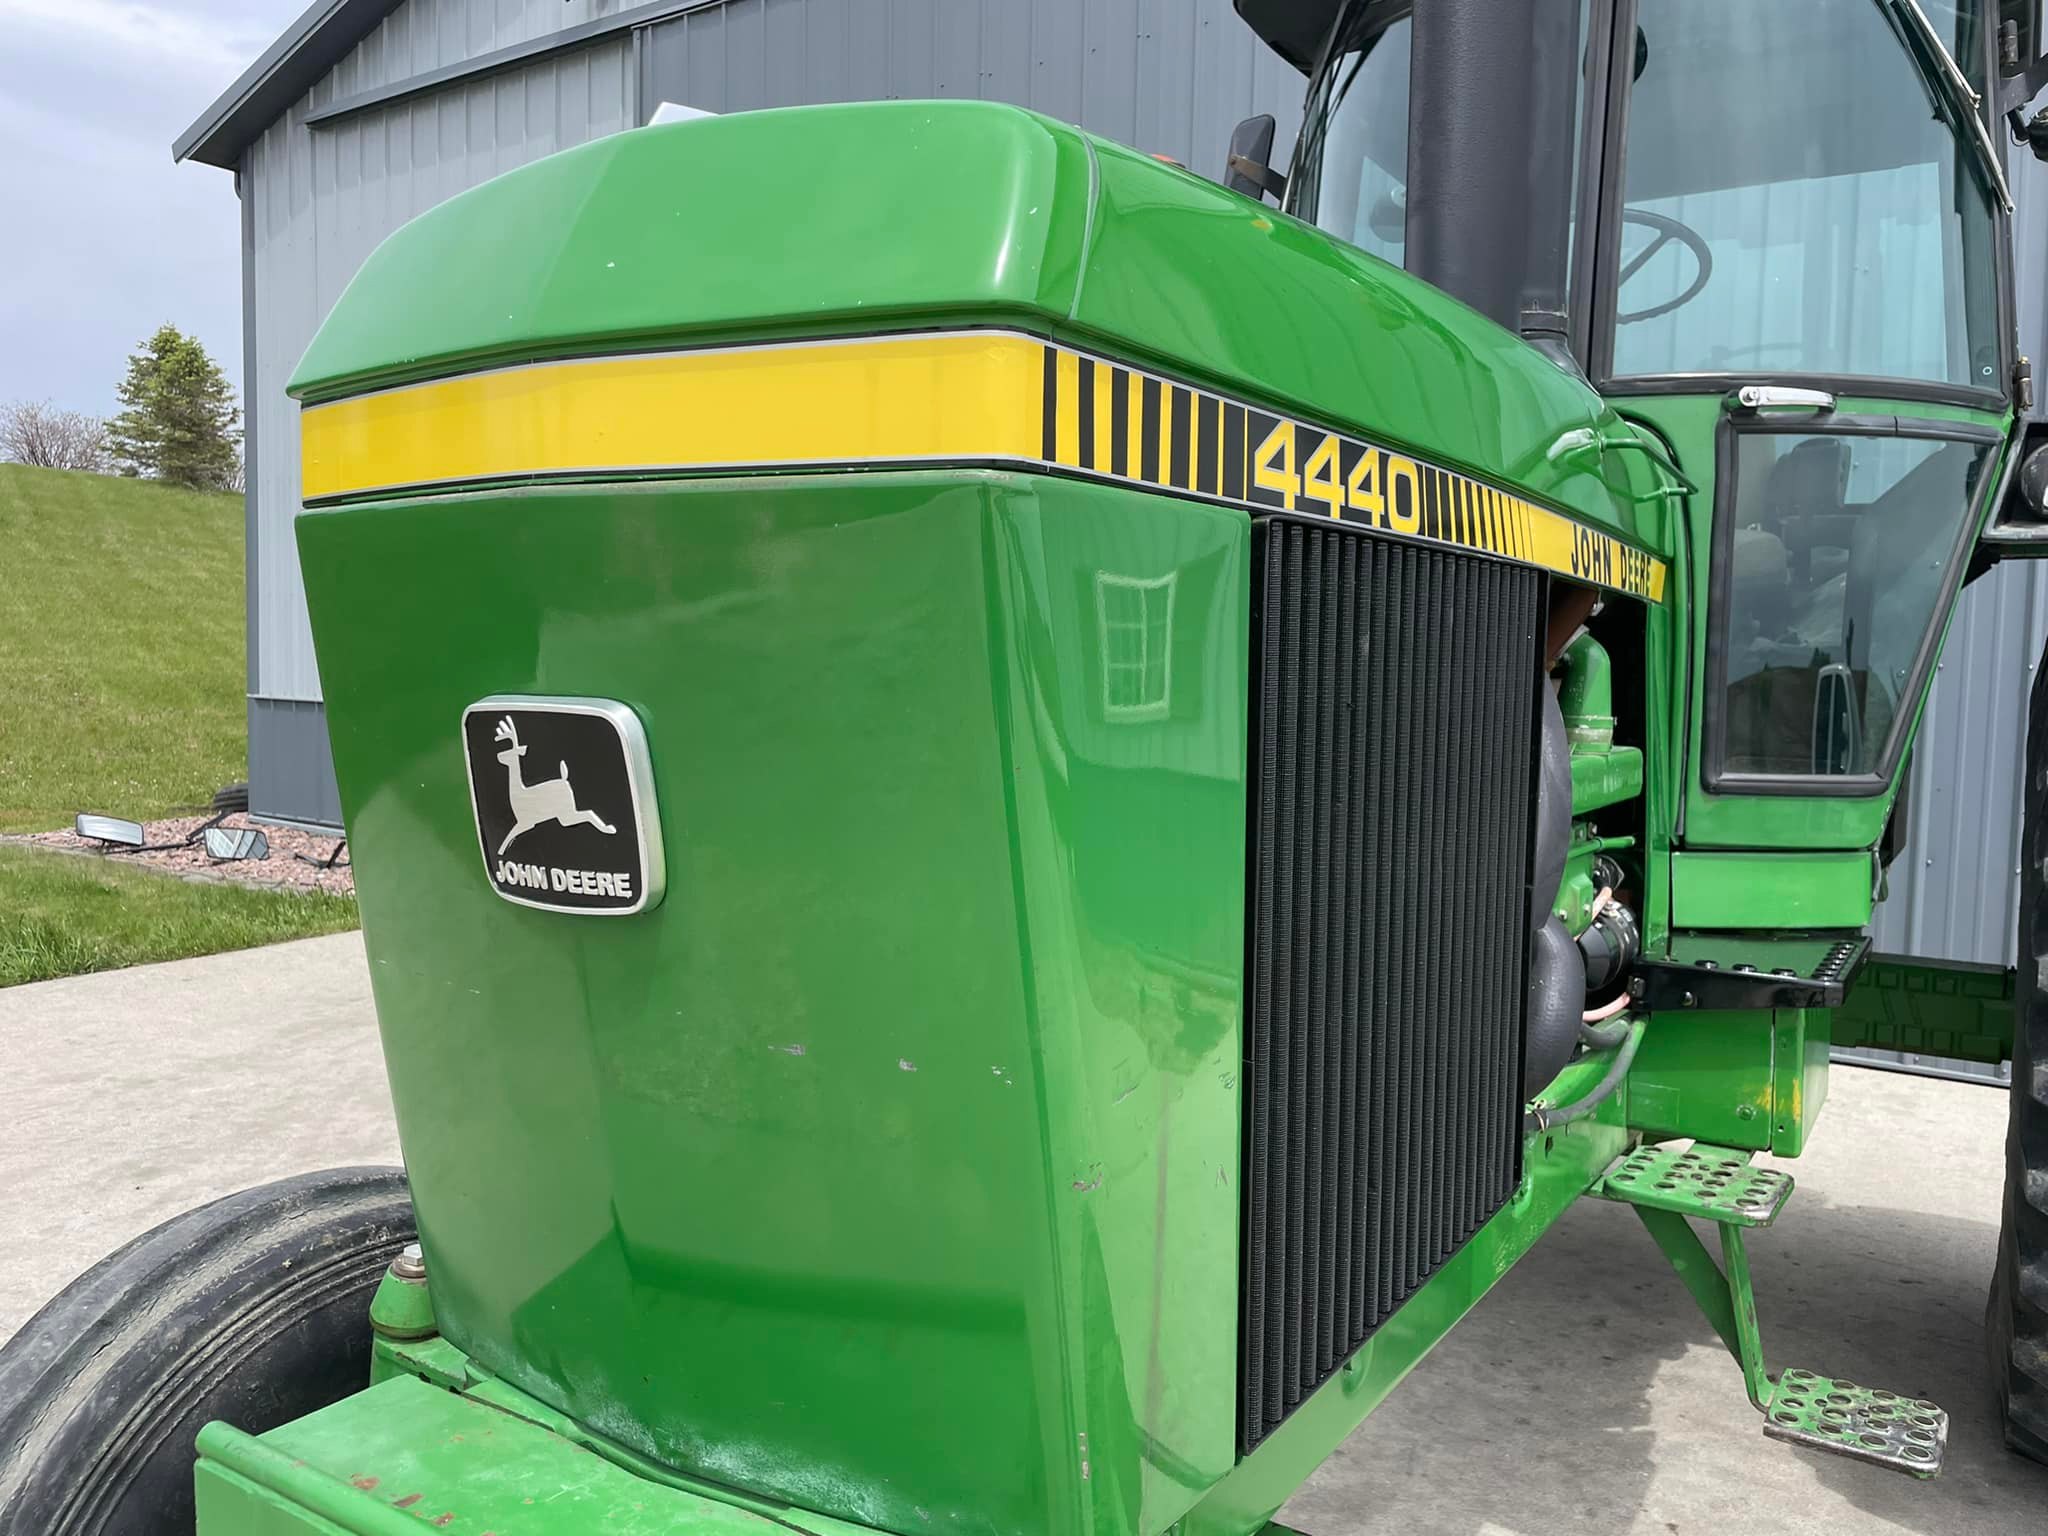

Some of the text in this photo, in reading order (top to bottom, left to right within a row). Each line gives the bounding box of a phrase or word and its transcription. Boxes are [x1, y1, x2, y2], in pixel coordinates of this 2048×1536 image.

[1254, 419, 1420, 535] 4440
[1571, 522, 1652, 597] JOHN DEERE
[496, 860, 633, 898] JOHN DEERE
